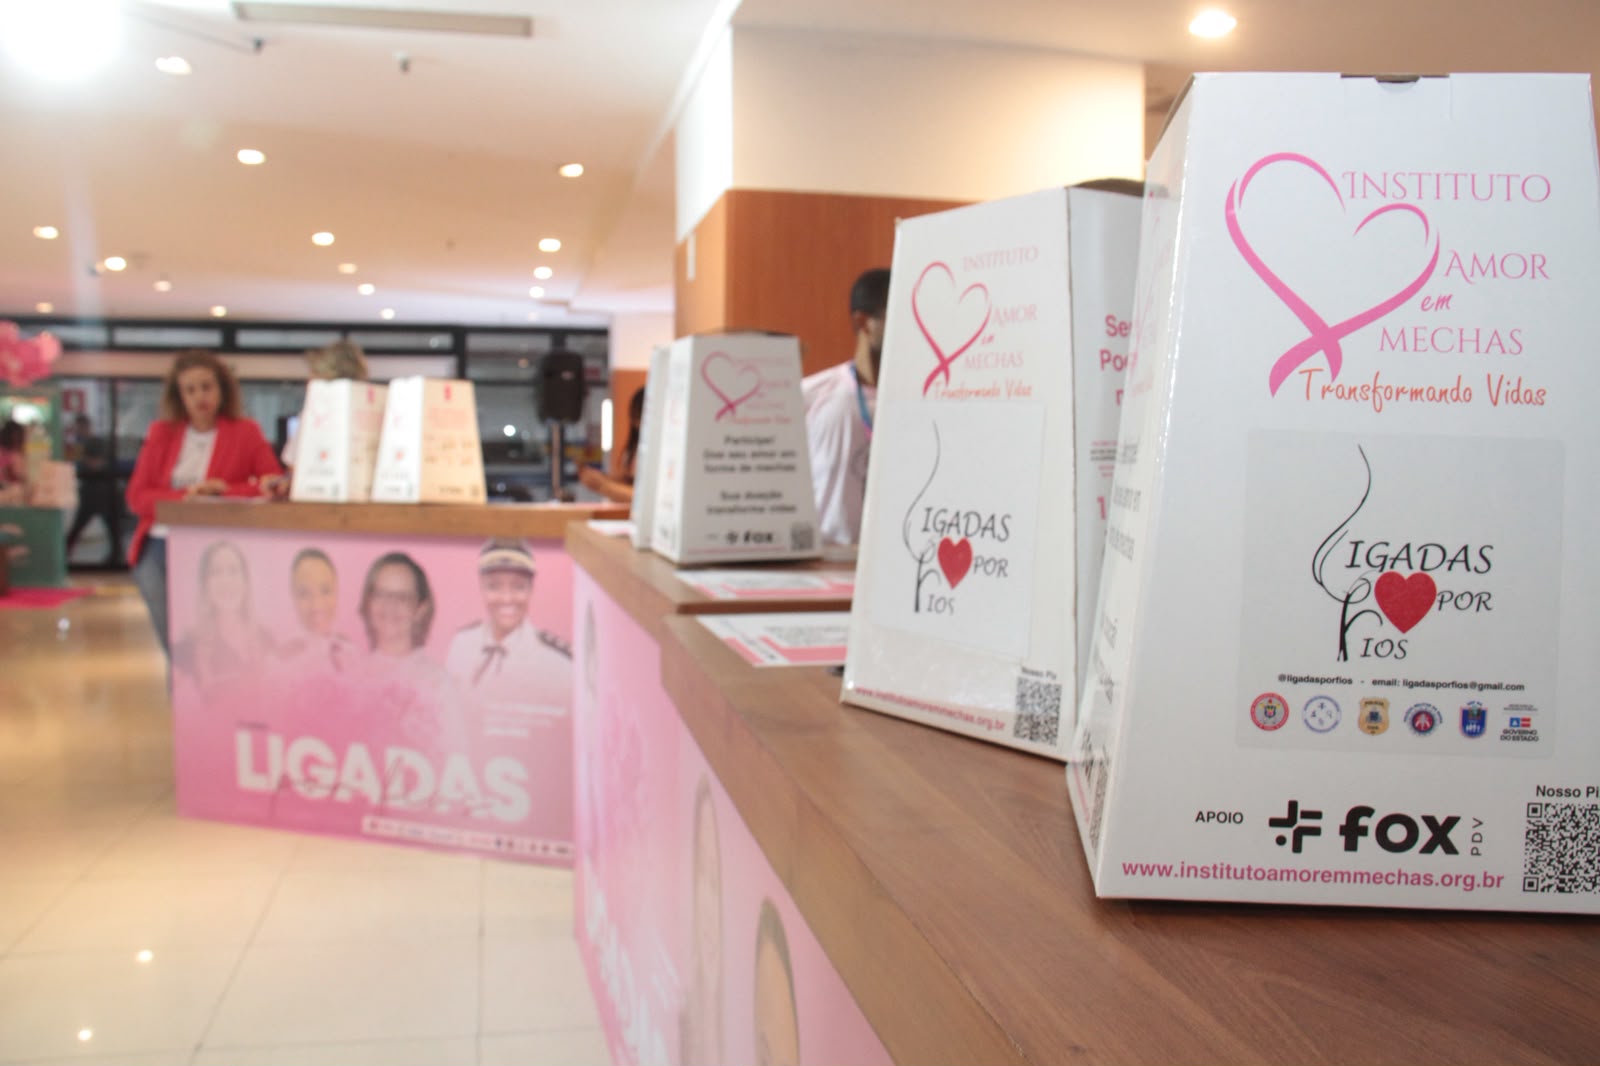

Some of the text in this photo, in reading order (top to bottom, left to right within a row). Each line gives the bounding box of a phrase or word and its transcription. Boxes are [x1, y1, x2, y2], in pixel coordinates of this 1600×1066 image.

[1342, 171, 1551, 203] INSTITUTO
[1443, 249, 1551, 285] AMOR
[1420, 292, 1453, 313] em
[1378, 326, 1524, 356] MECHAS
[1299, 368, 1548, 414] Transformando Vidas
[973, 554, 1009, 578] POR
[1436, 589, 1494, 613] POR
[1277, 673, 1354, 686] @ligadasporfios
[1401, 679, 1526, 692] ligadasporfios@gmail.com
[235, 728, 532, 824] LIGADAS
[1535, 784, 1582, 798] Nosso
[1195, 805, 1484, 857] APOIO fox PDV
[1121, 860, 1505, 892] www.institutoamoremmechas.org.br
